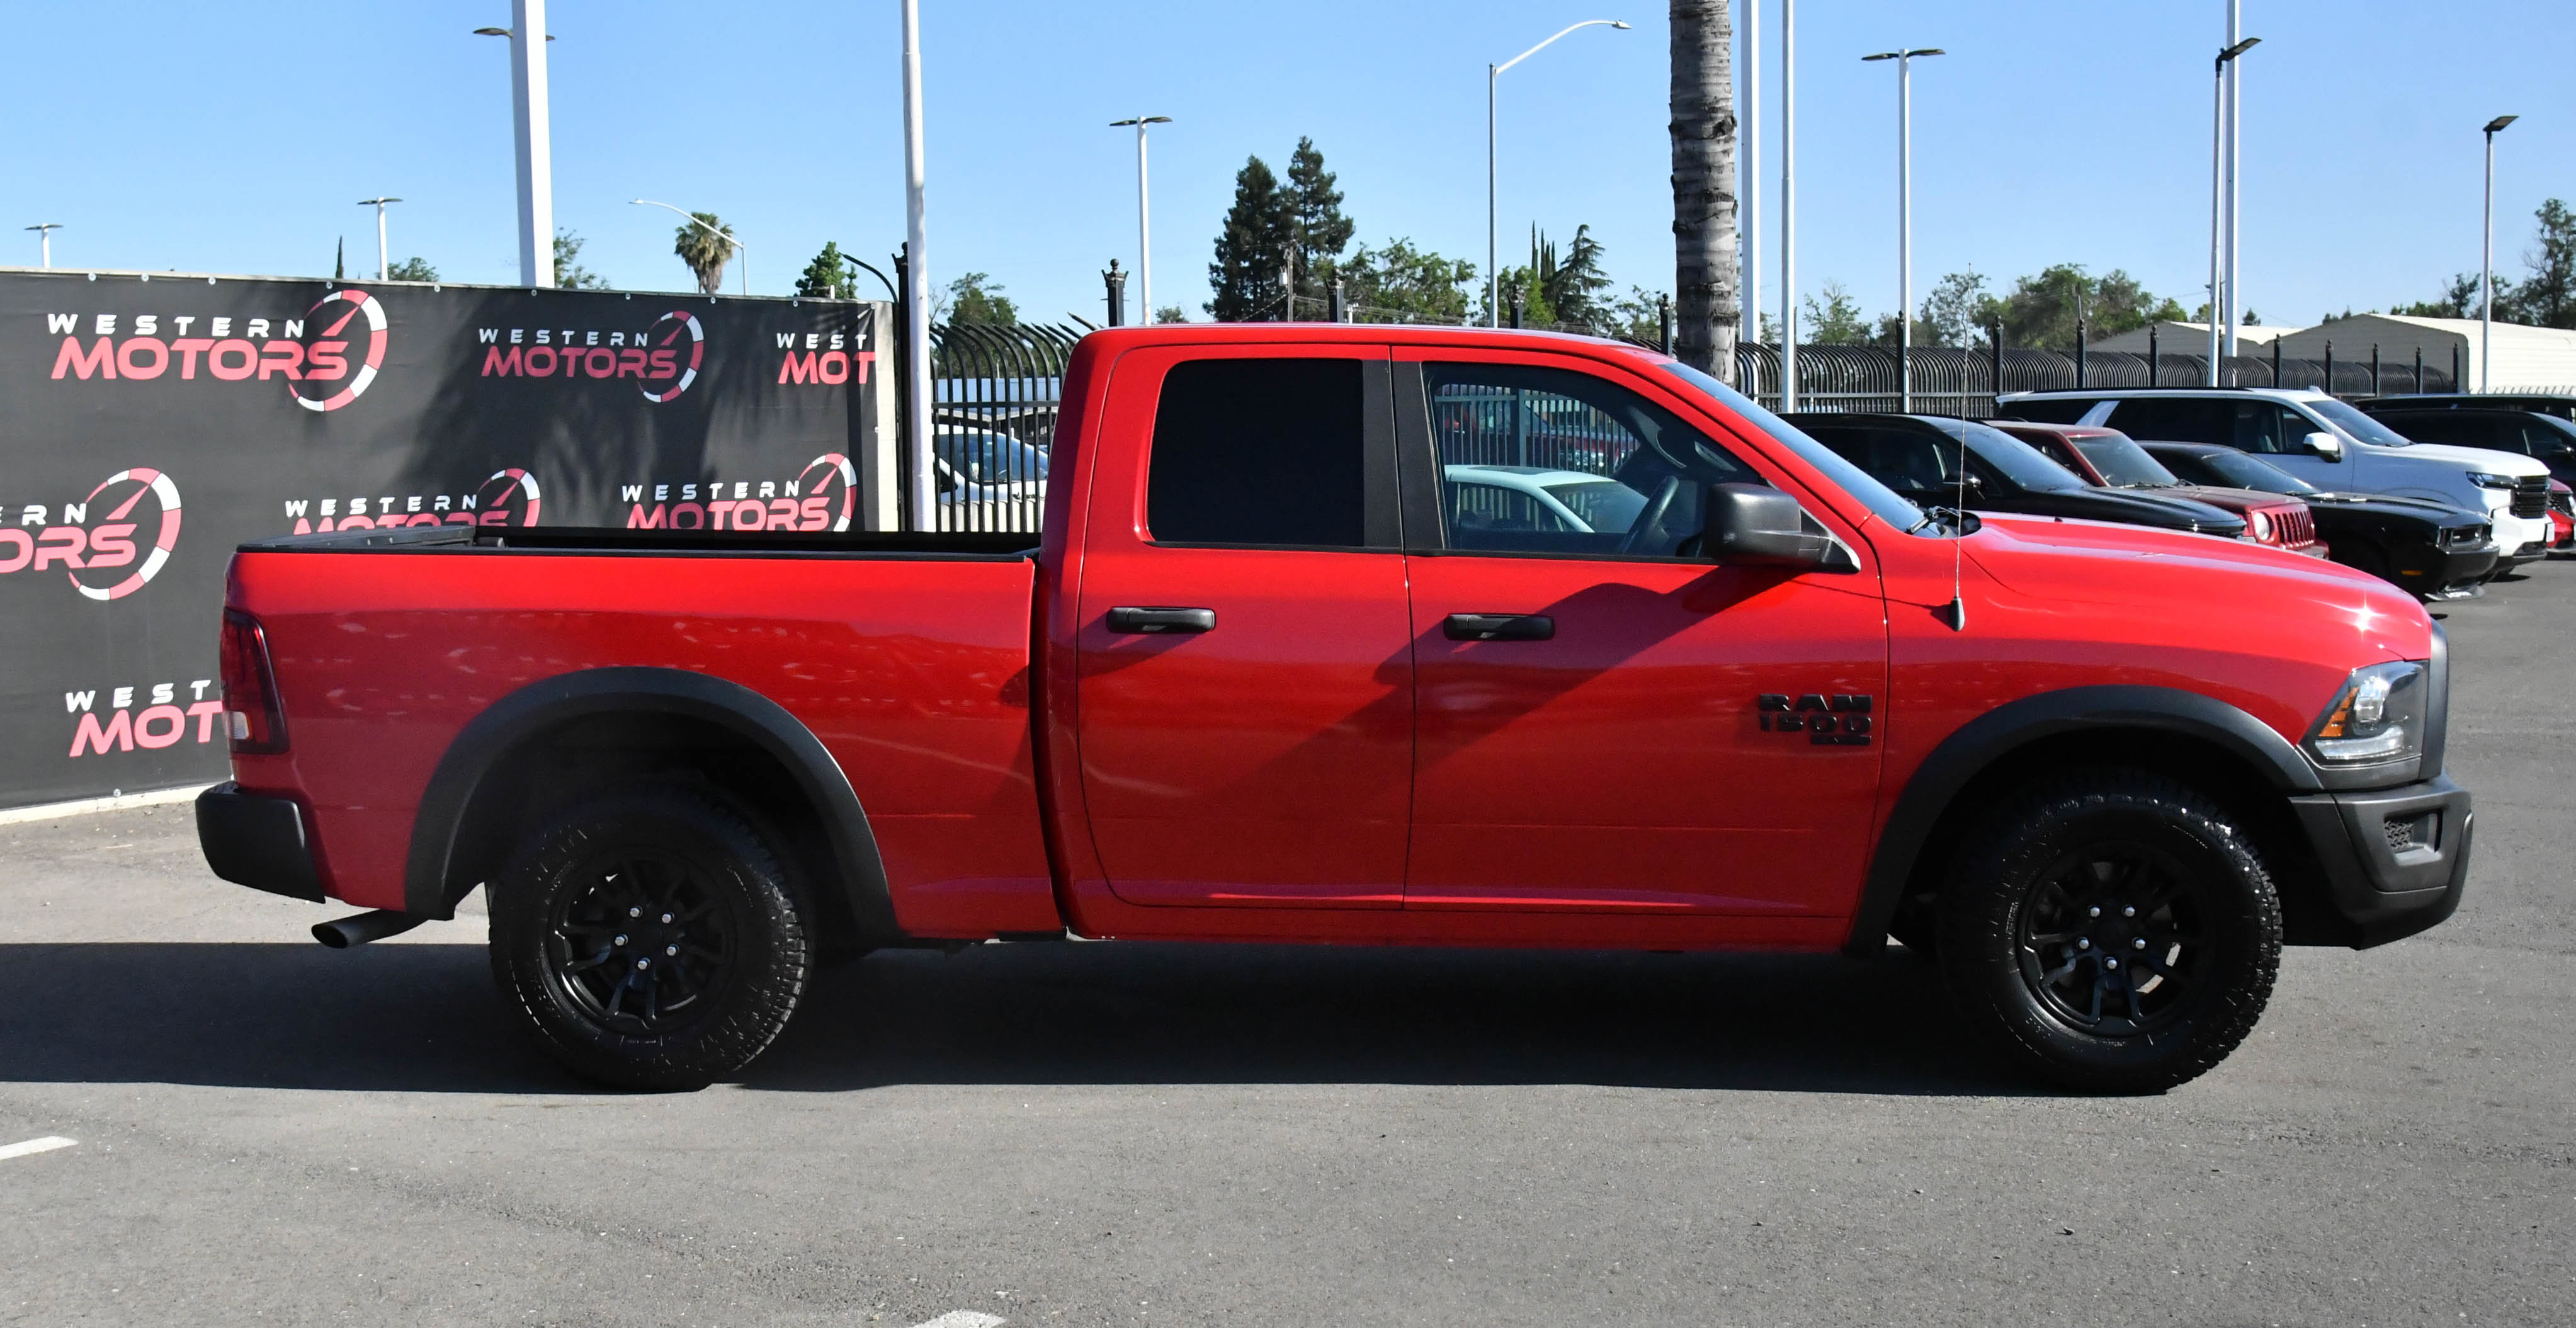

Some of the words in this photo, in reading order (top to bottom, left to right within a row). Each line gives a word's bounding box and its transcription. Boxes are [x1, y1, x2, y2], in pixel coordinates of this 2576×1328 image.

[48, 313, 305, 338] WESTERN
[479, 328, 649, 347] WESTERN
[776, 332, 867, 350] WEST
[52, 336, 349, 382] MOTORS
[481, 345, 678, 379] MOTORS
[778, 350, 876, 385] MOT
[621, 480, 800, 502] WESTERN
[0, 502, 87, 527] RN
[285, 494, 477, 518] WESTERN
[627, 496, 831, 532] MOTORS
[65, 679, 212, 713] WEST
[1759, 693, 1873, 712] RAM
[69, 700, 223, 758] MOT
[1760, 713, 1872, 732] 1500
